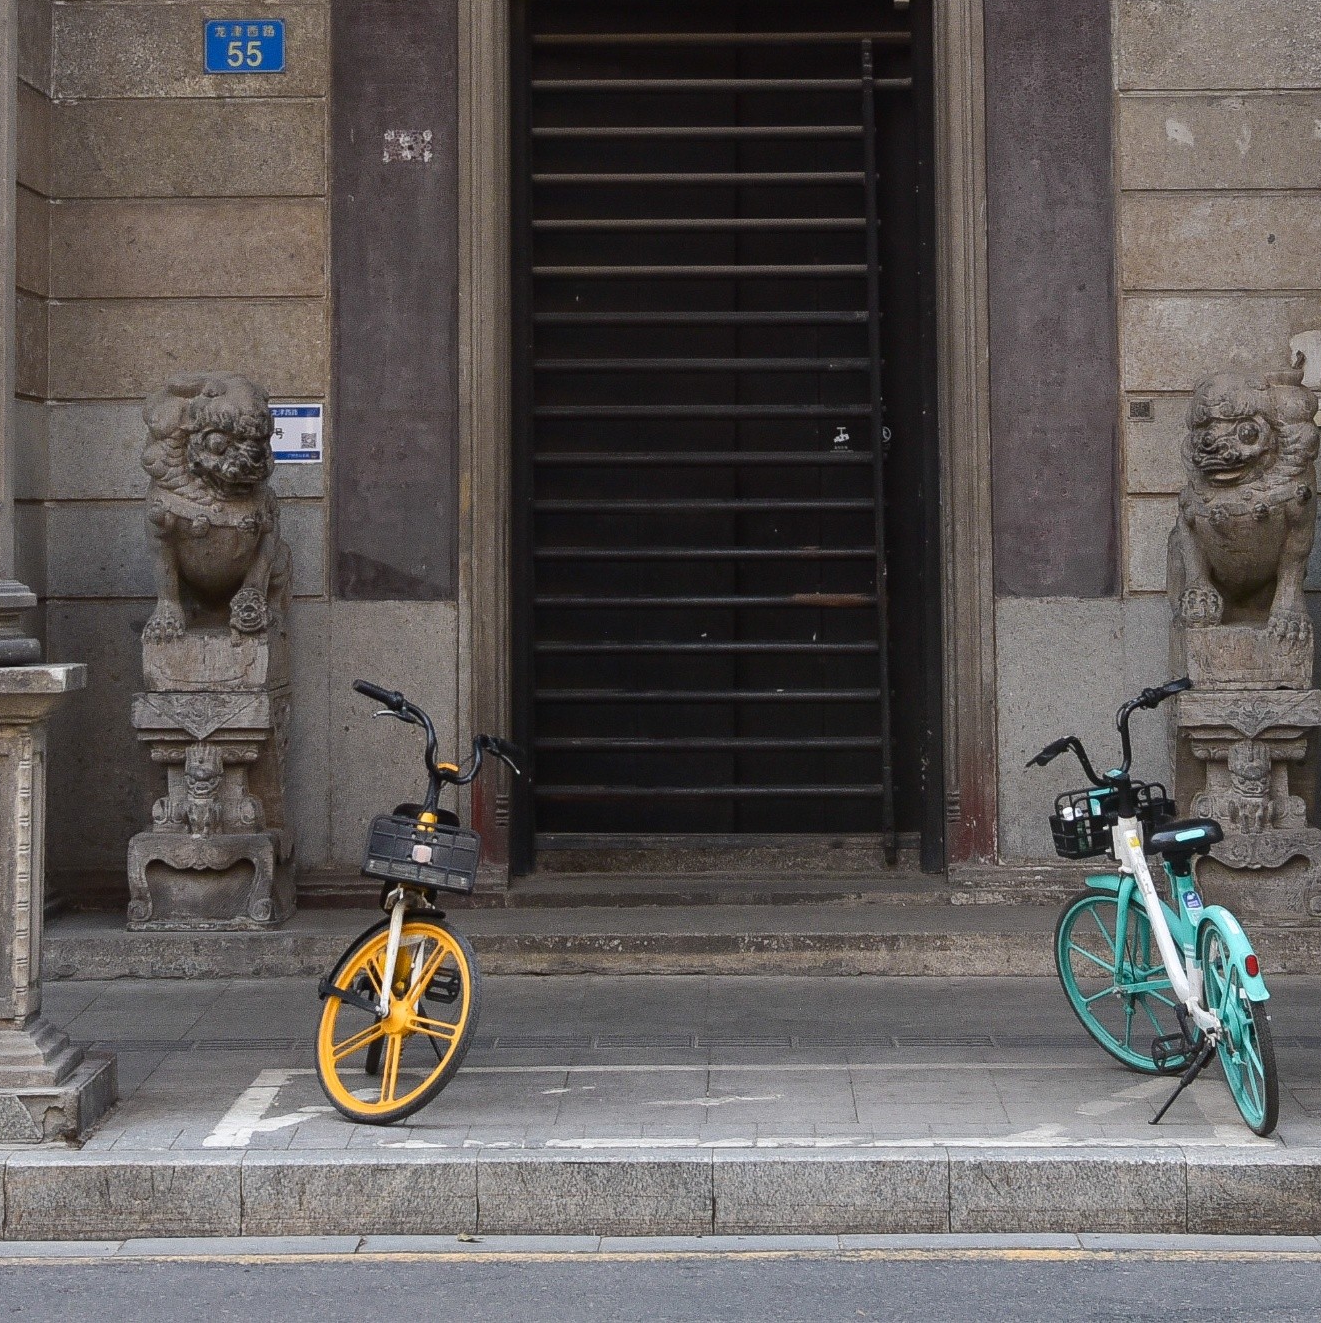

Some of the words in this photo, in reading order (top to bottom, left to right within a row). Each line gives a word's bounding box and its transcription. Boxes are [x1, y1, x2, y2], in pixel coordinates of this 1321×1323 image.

[215, 25, 275, 38] 龙津西路
[226, 41, 263, 67] 55
